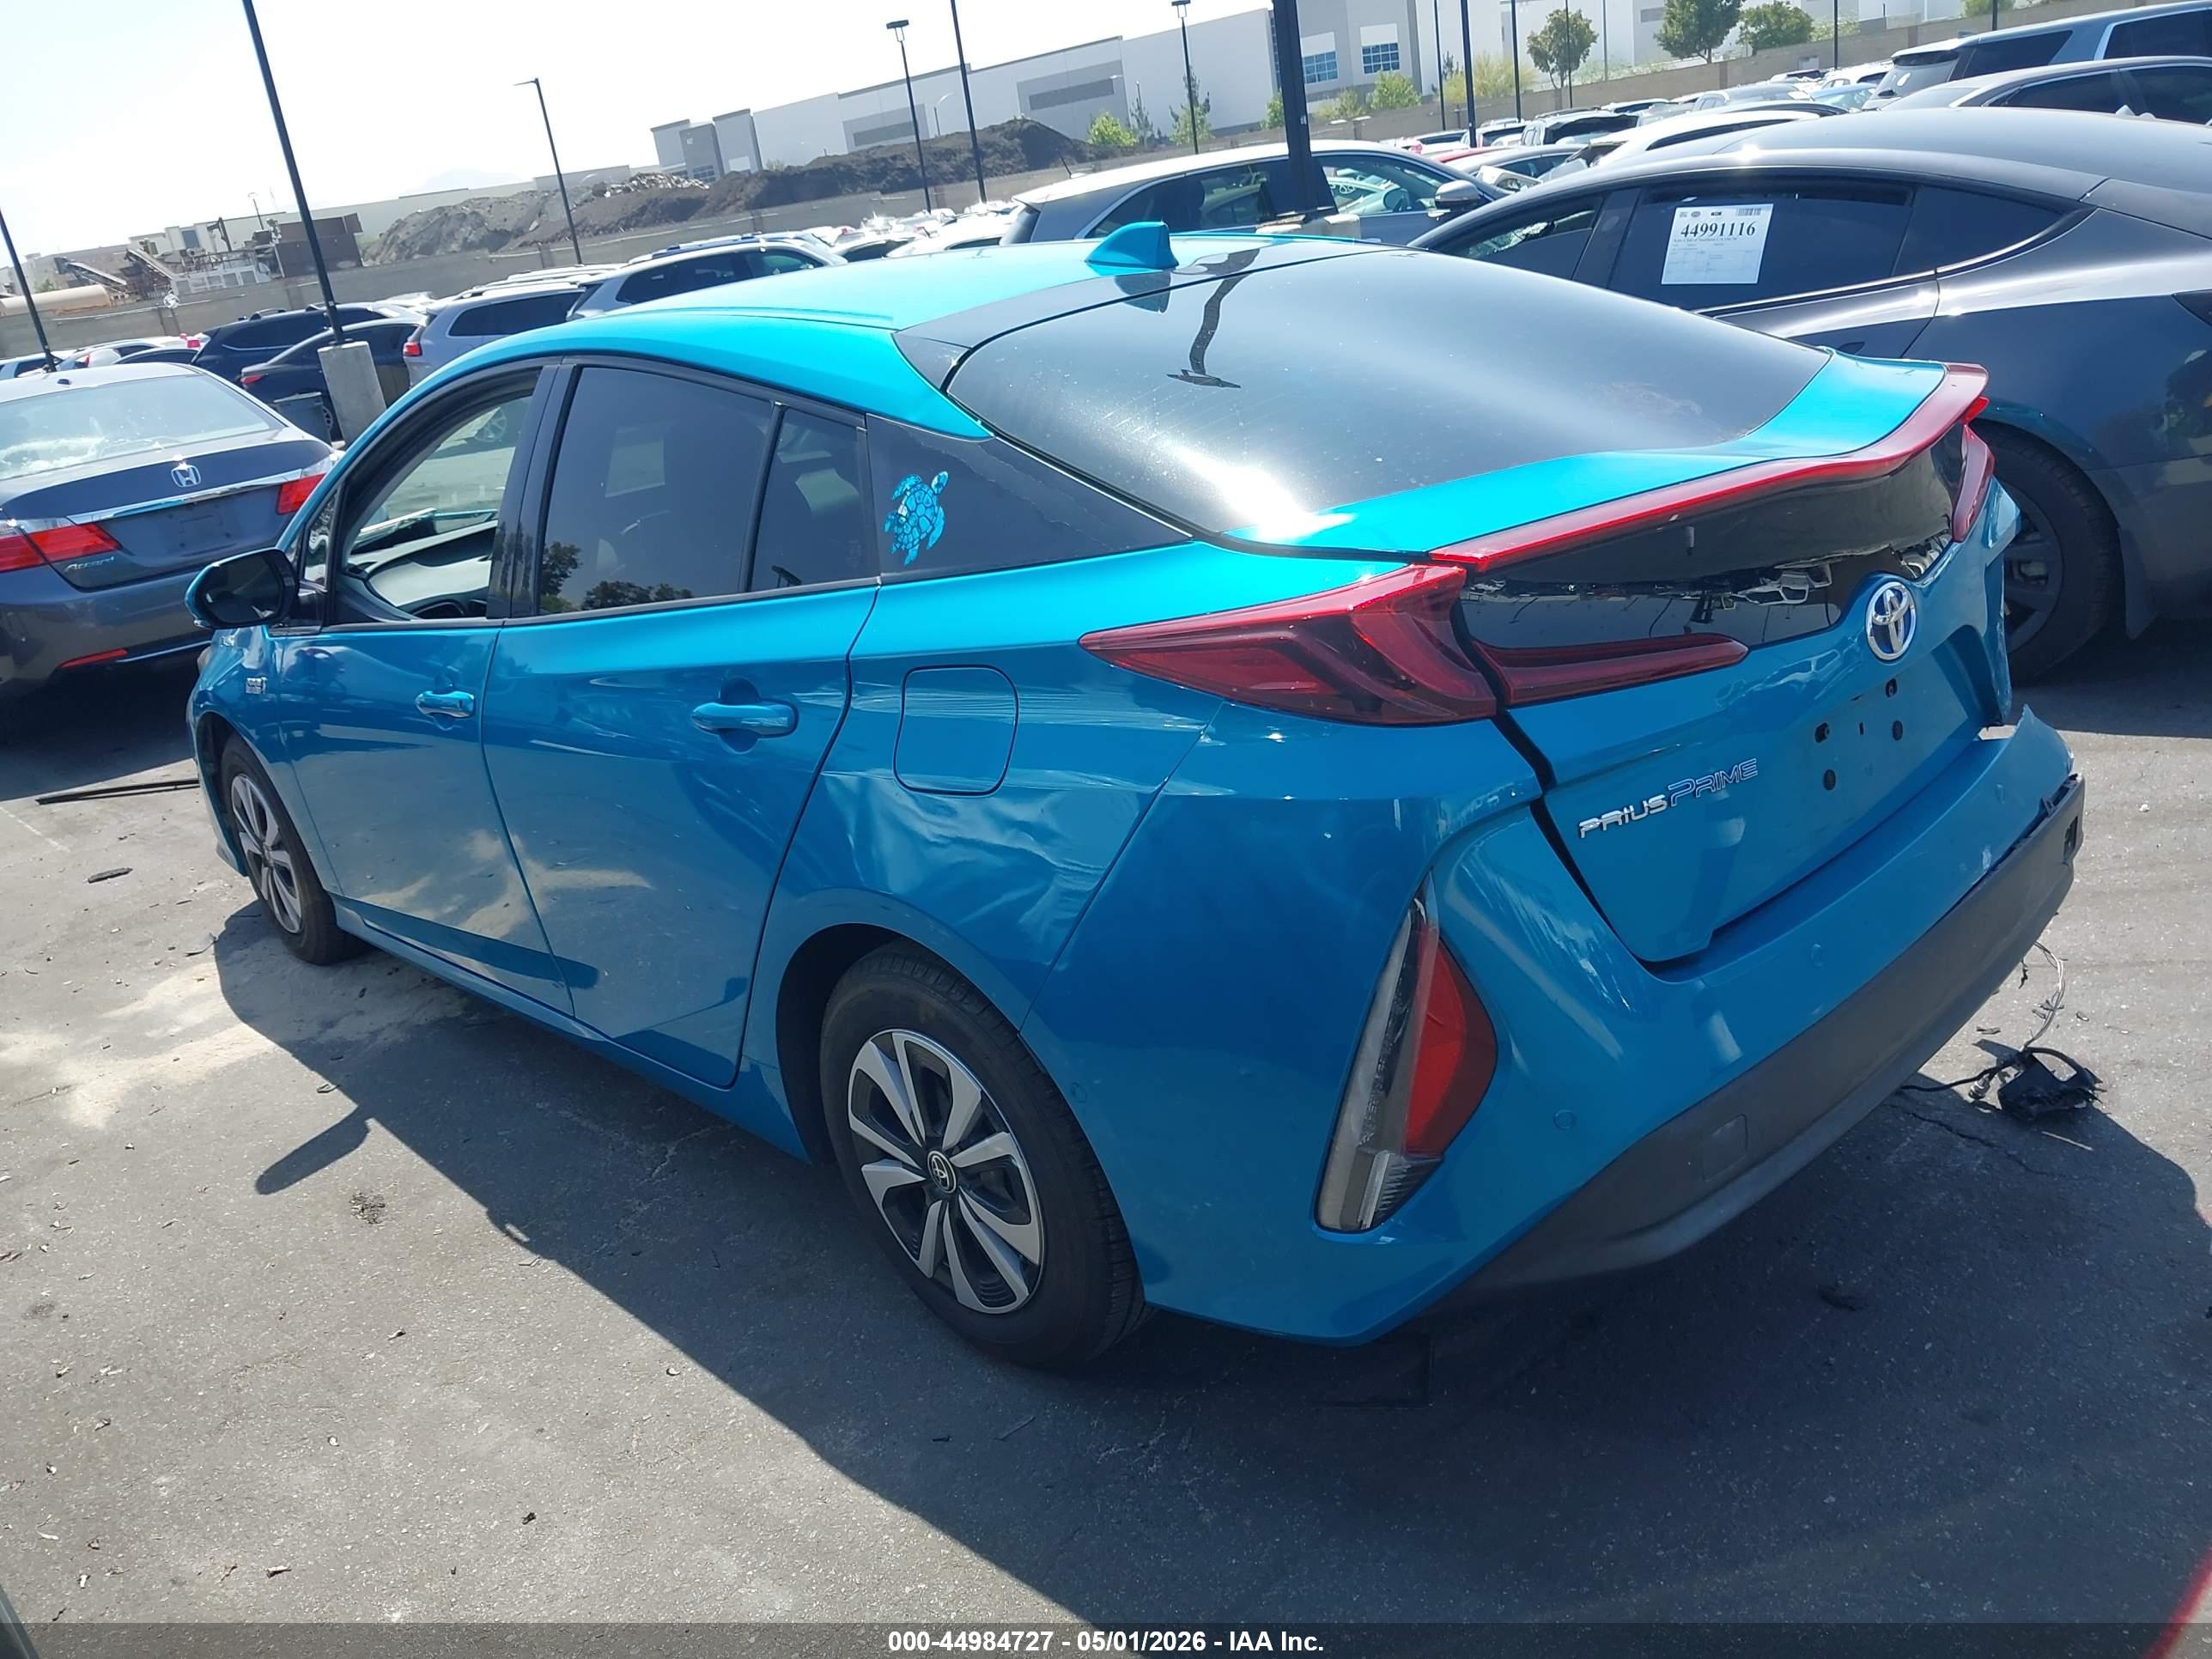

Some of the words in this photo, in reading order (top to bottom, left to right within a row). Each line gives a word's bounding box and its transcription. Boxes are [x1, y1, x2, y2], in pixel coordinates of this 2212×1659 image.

[1680, 221, 1756, 238] 44991116
[1578, 793, 1668, 839] PRIUS
[1668, 757, 1759, 807] PRIME
